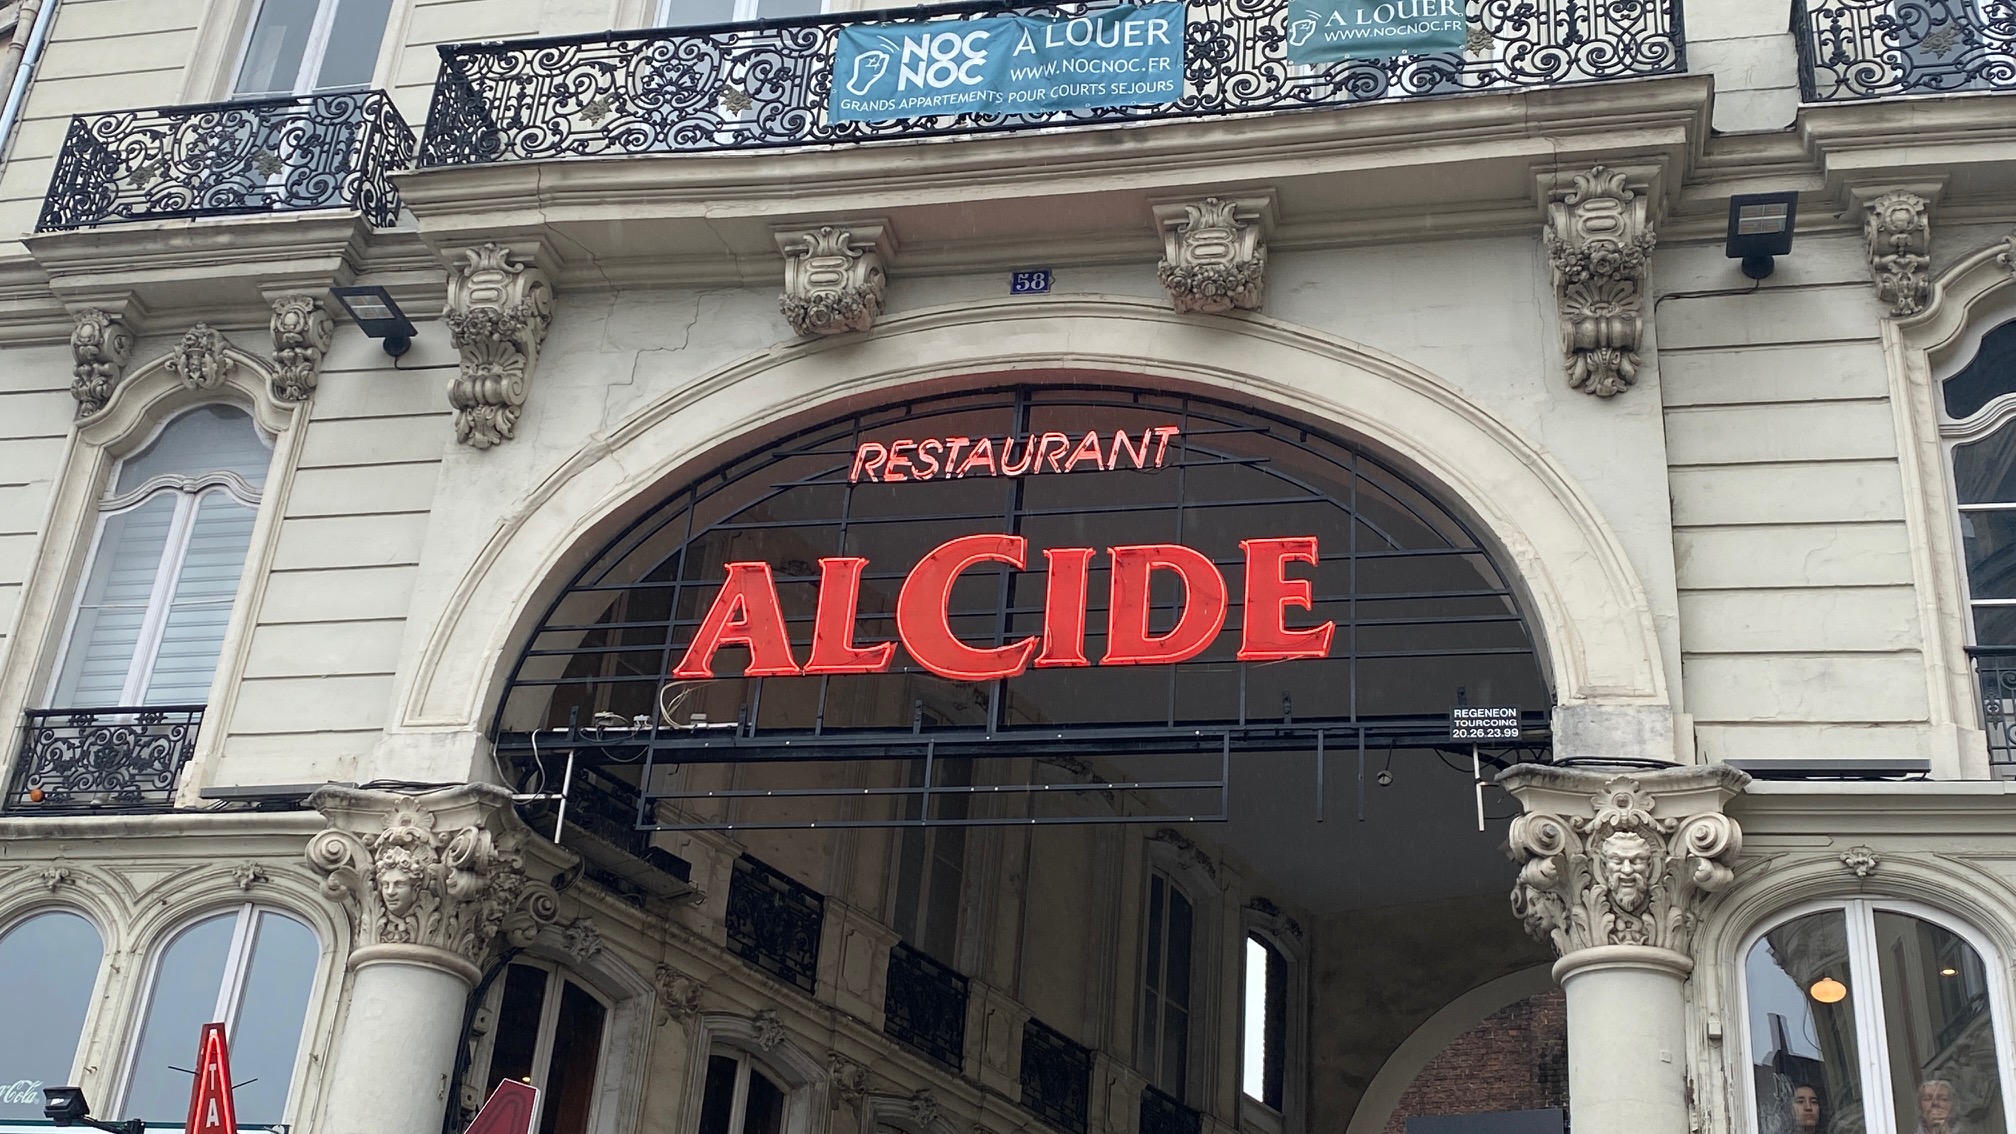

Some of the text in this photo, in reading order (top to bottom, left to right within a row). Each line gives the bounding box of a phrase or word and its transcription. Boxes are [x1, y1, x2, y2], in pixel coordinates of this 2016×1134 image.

[1324, 0, 1459, 27] A LOUER
[1012, 17, 1171, 57] A LOUER
[1324, 20, 1462, 42] WWW.NOCNOC.FR
[902, 30, 991, 64] NOC
[897, 57, 988, 91] NOC
[1010, 57, 1171, 82] WWW.NOCNOC.FR
[840, 79, 1174, 112] GRANDS APPARTEMENTS POUR COURTS SEJOURS
[1016, 272, 1045, 291] 58
[850, 425, 1180, 484] RESTAURANT
[671, 532, 1337, 681] ALCIDE
[1453, 708, 1517, 718] REGENEON
[1453, 719, 1517, 727] TOURCOING
[1452, 728, 1519, 738] 20.26.23.99
